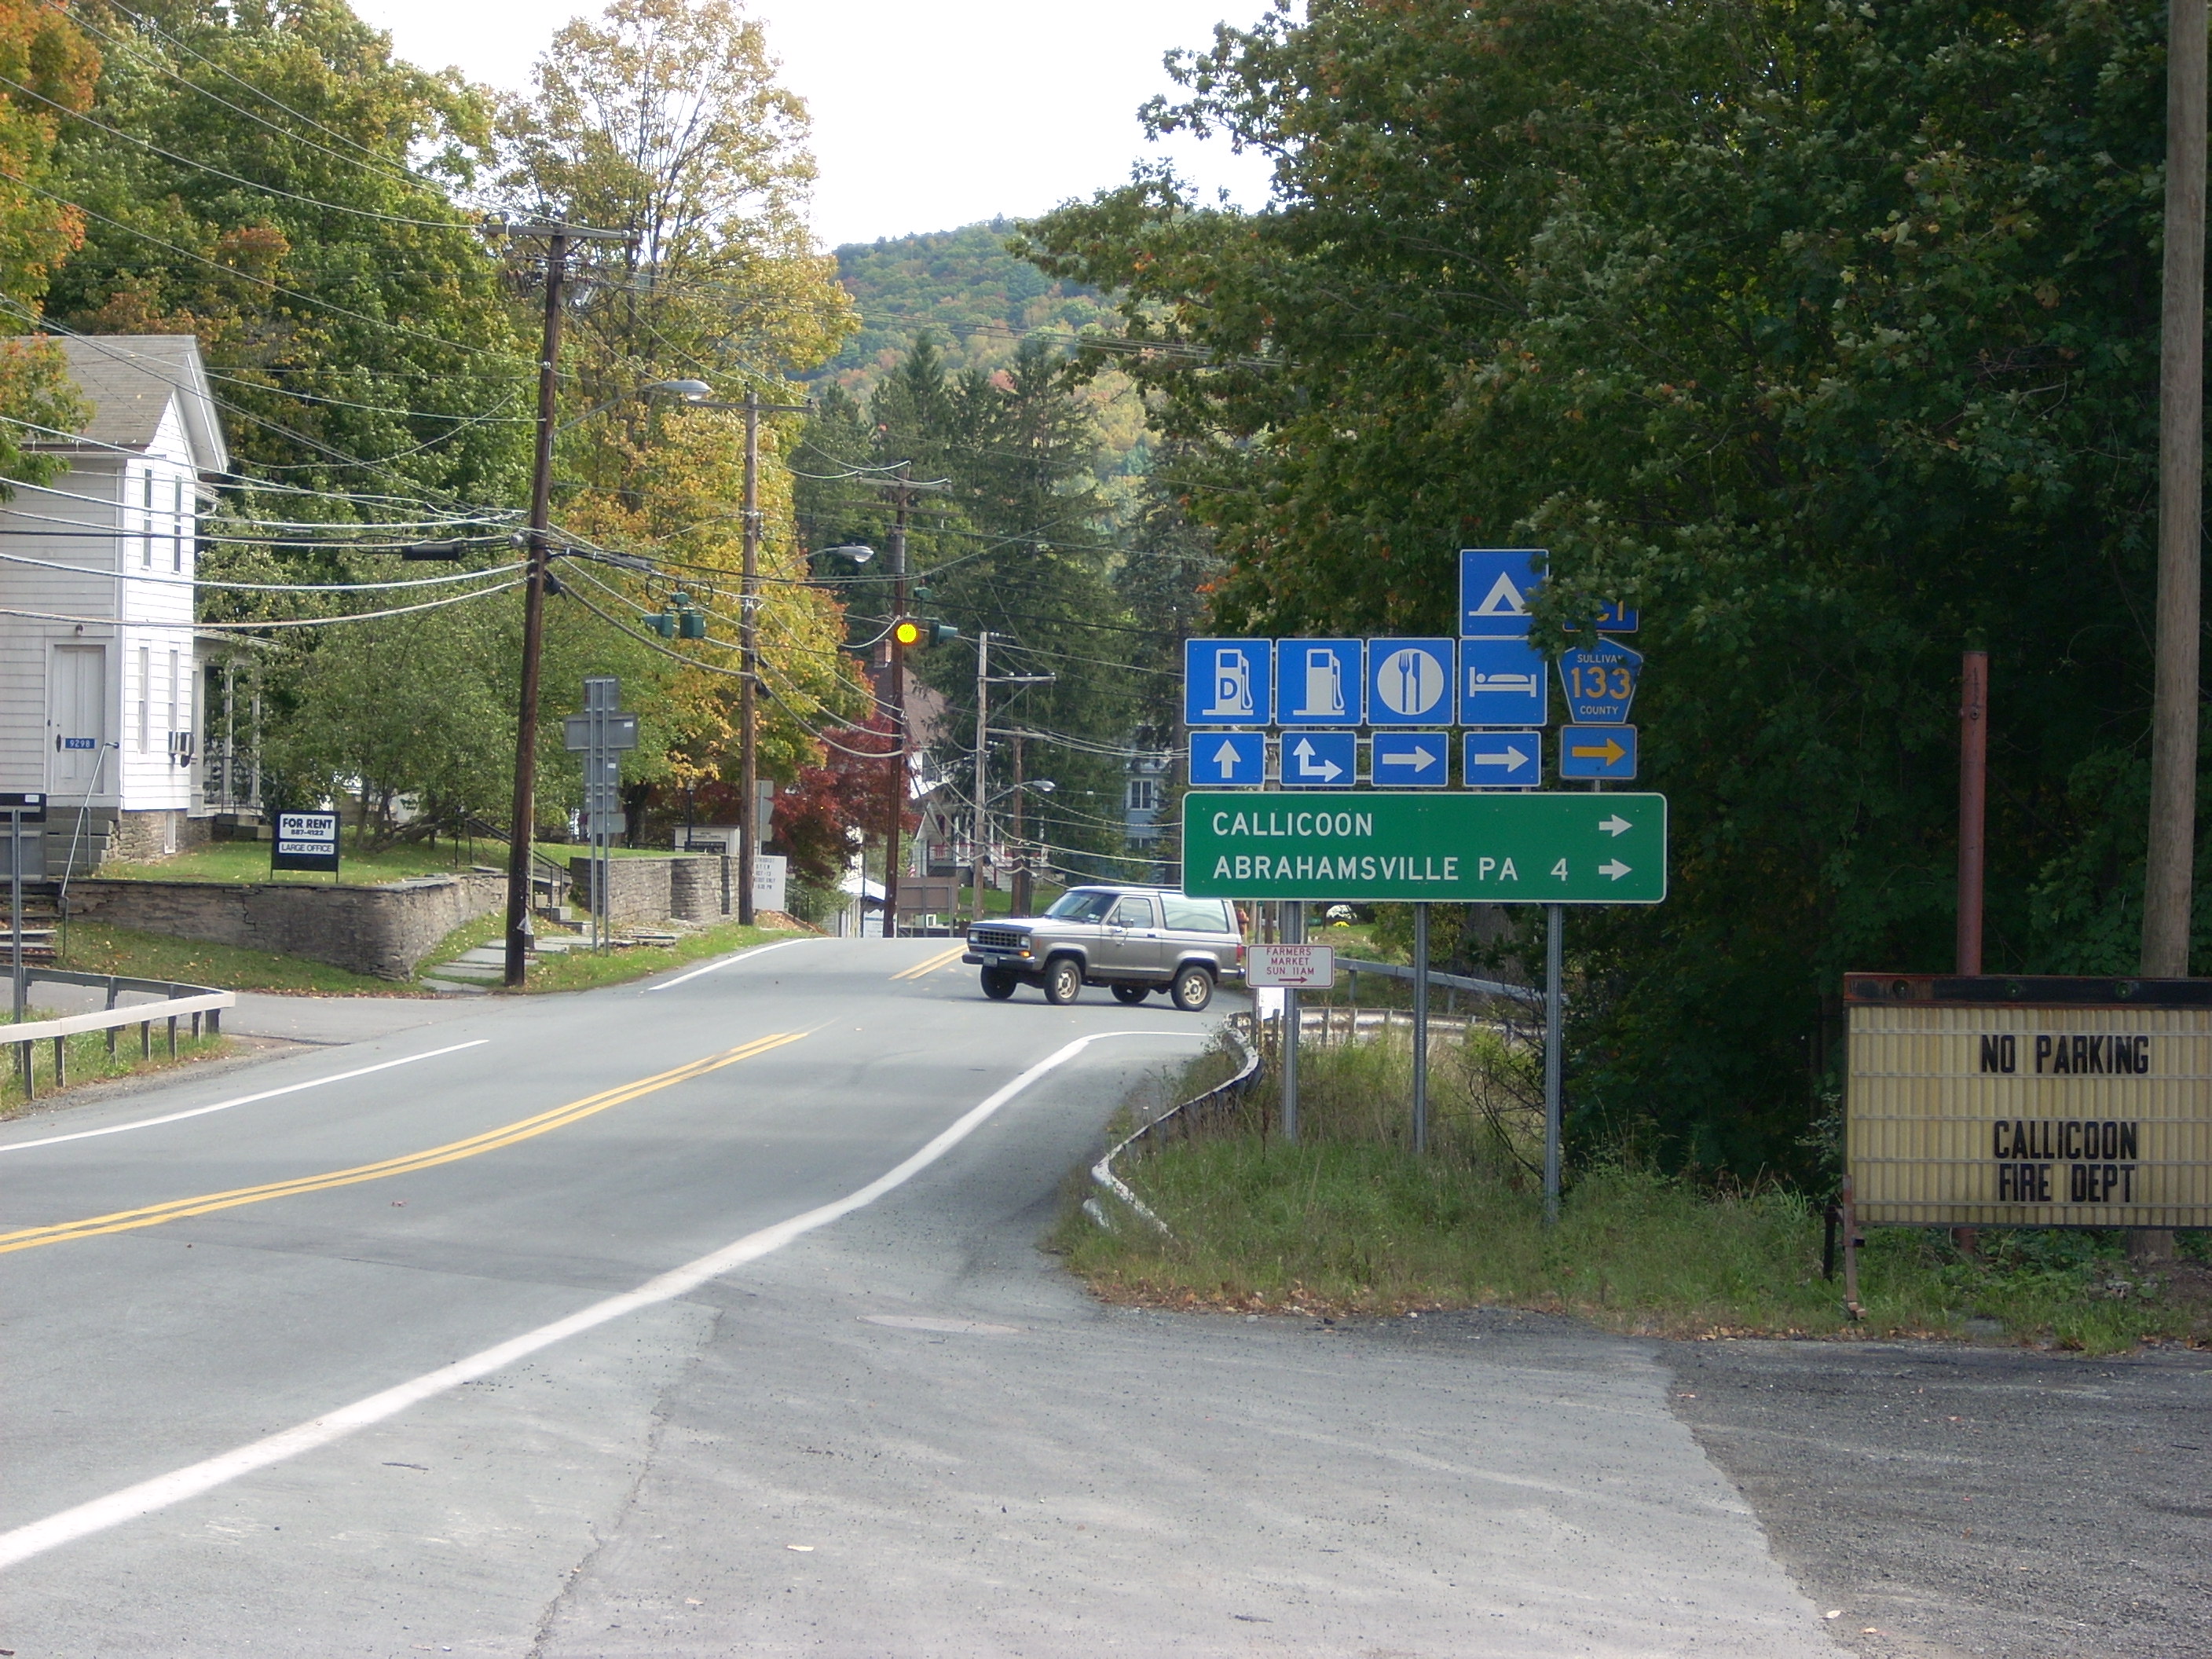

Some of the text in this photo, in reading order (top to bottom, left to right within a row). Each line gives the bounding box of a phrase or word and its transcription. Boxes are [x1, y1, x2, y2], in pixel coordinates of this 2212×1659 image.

[1571, 666, 1632, 700] 133
[1580, 705, 1619, 715] COUNTY
[70, 739, 90, 748] 9298
[283, 818, 333, 829] FOR RENT
[1212, 811, 1373, 837] CALLICOON
[281, 844, 331, 853] LARGE OFFICE
[1213, 855, 1569, 881] ABRAHAMSVILLE PA 4
[1293, 967, 1315, 976] 11AM
[1981, 1035, 2149, 1075] NO PARKING
[1994, 1120, 2137, 1160] CALLICOON
[1999, 1163, 2135, 1203] FIRE DEPT
